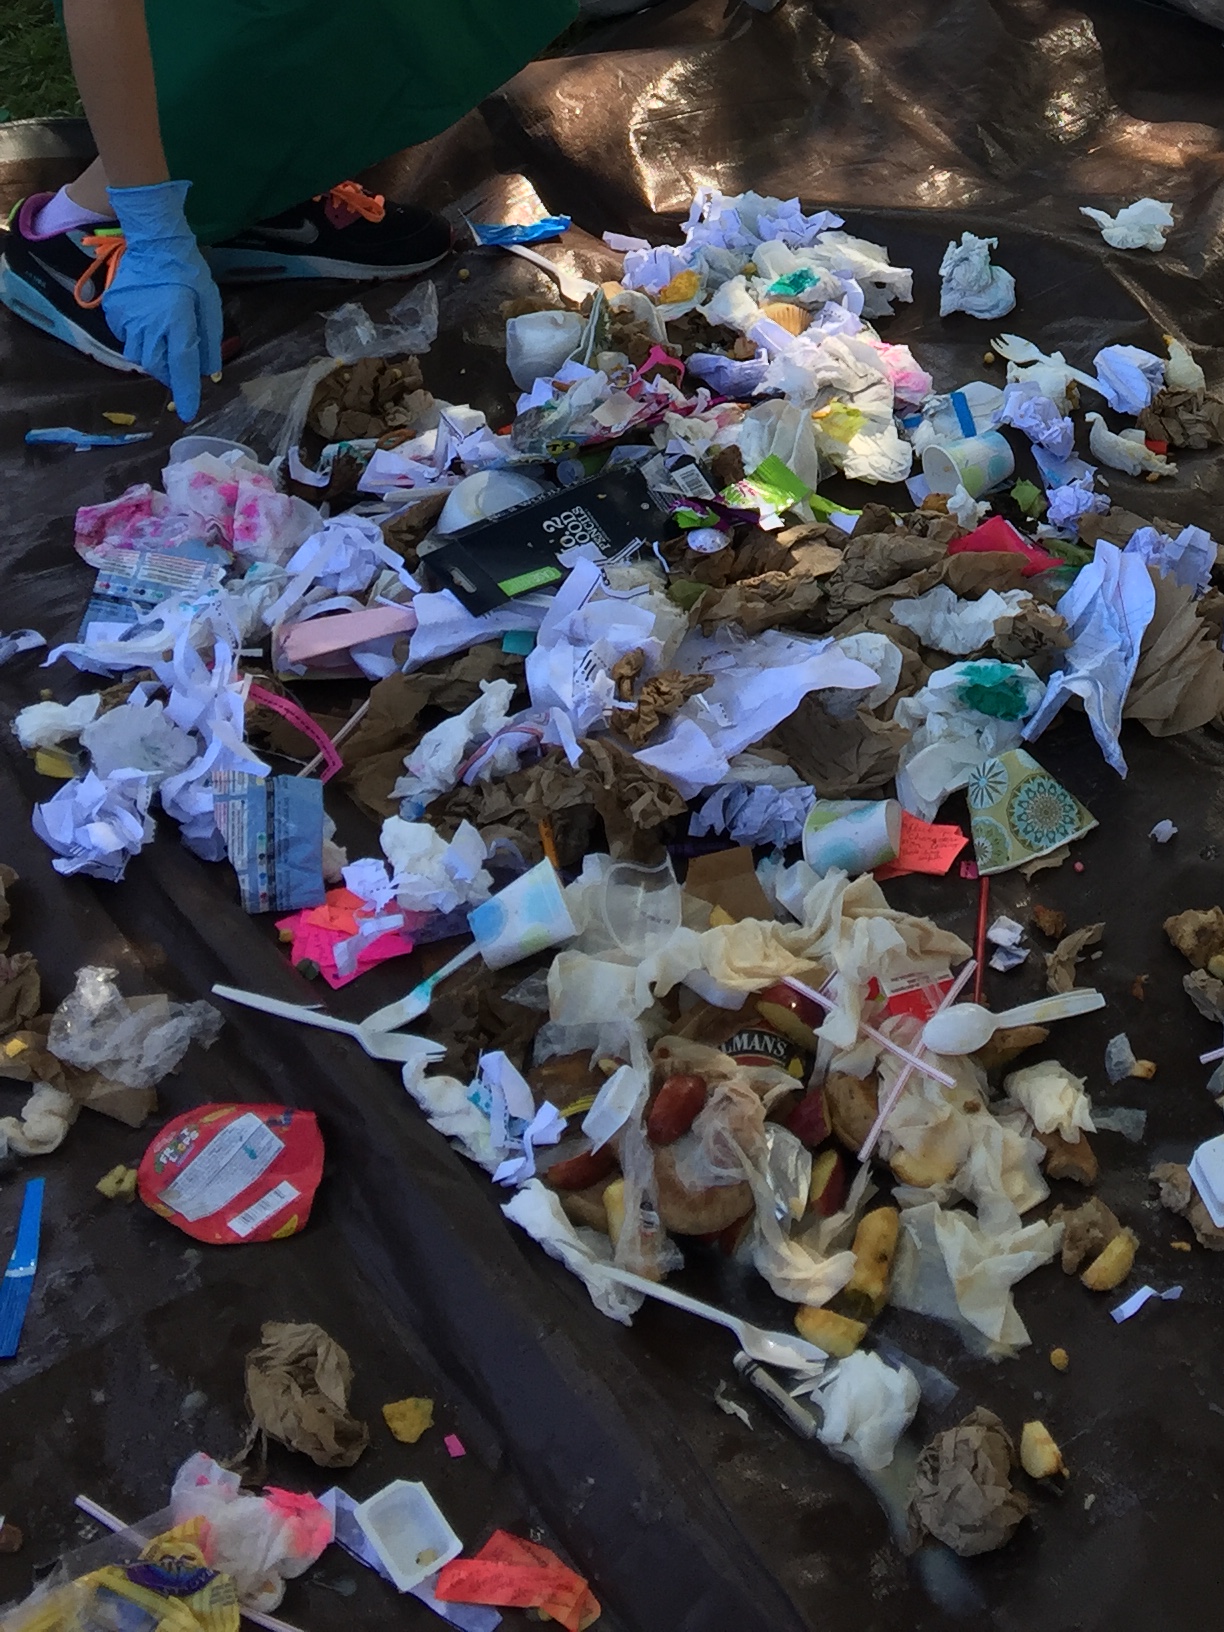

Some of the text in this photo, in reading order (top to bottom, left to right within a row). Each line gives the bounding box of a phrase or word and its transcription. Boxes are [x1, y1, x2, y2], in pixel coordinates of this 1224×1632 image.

[542, 517, 565, 533] 2
[559, 511, 592, 545] OOD
[572, 505, 611, 550] PENCILS
